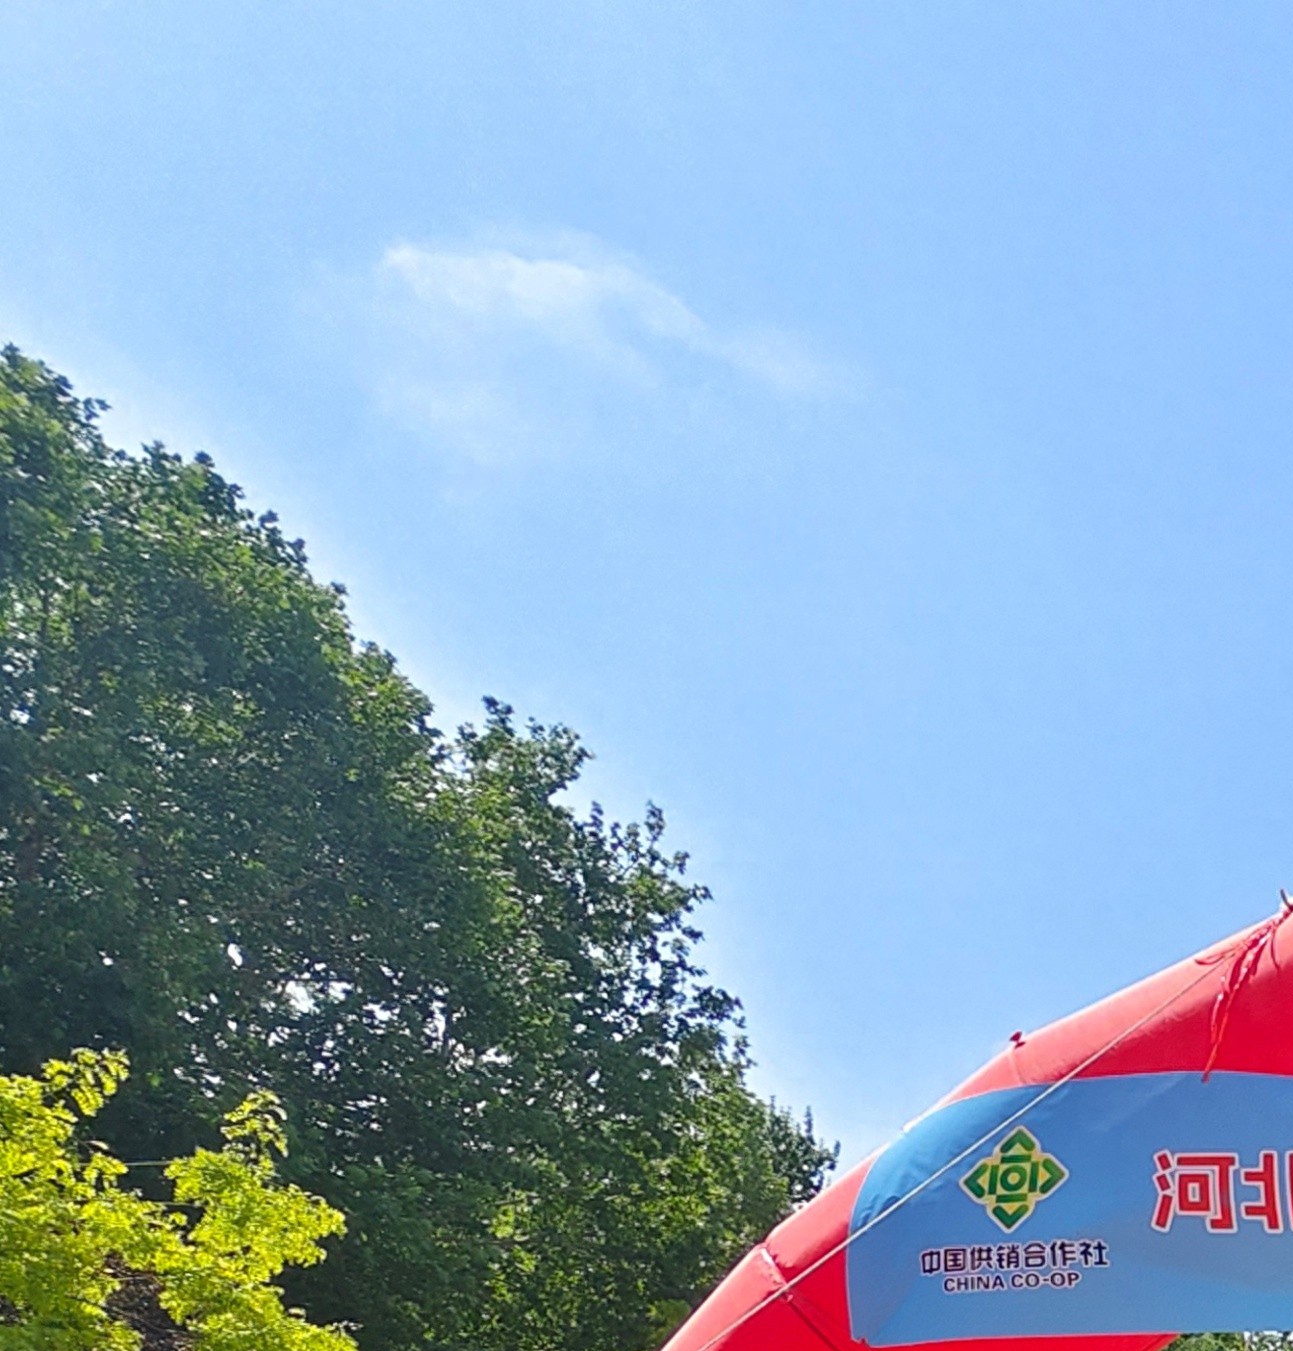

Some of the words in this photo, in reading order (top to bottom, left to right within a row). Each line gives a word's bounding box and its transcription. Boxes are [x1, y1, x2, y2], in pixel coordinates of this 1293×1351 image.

[921, 1241, 1109, 1274] 中国供销合作社
[944, 1274, 1005, 1292] CHINA
[1010, 1271, 1080, 1290] CO-OP
